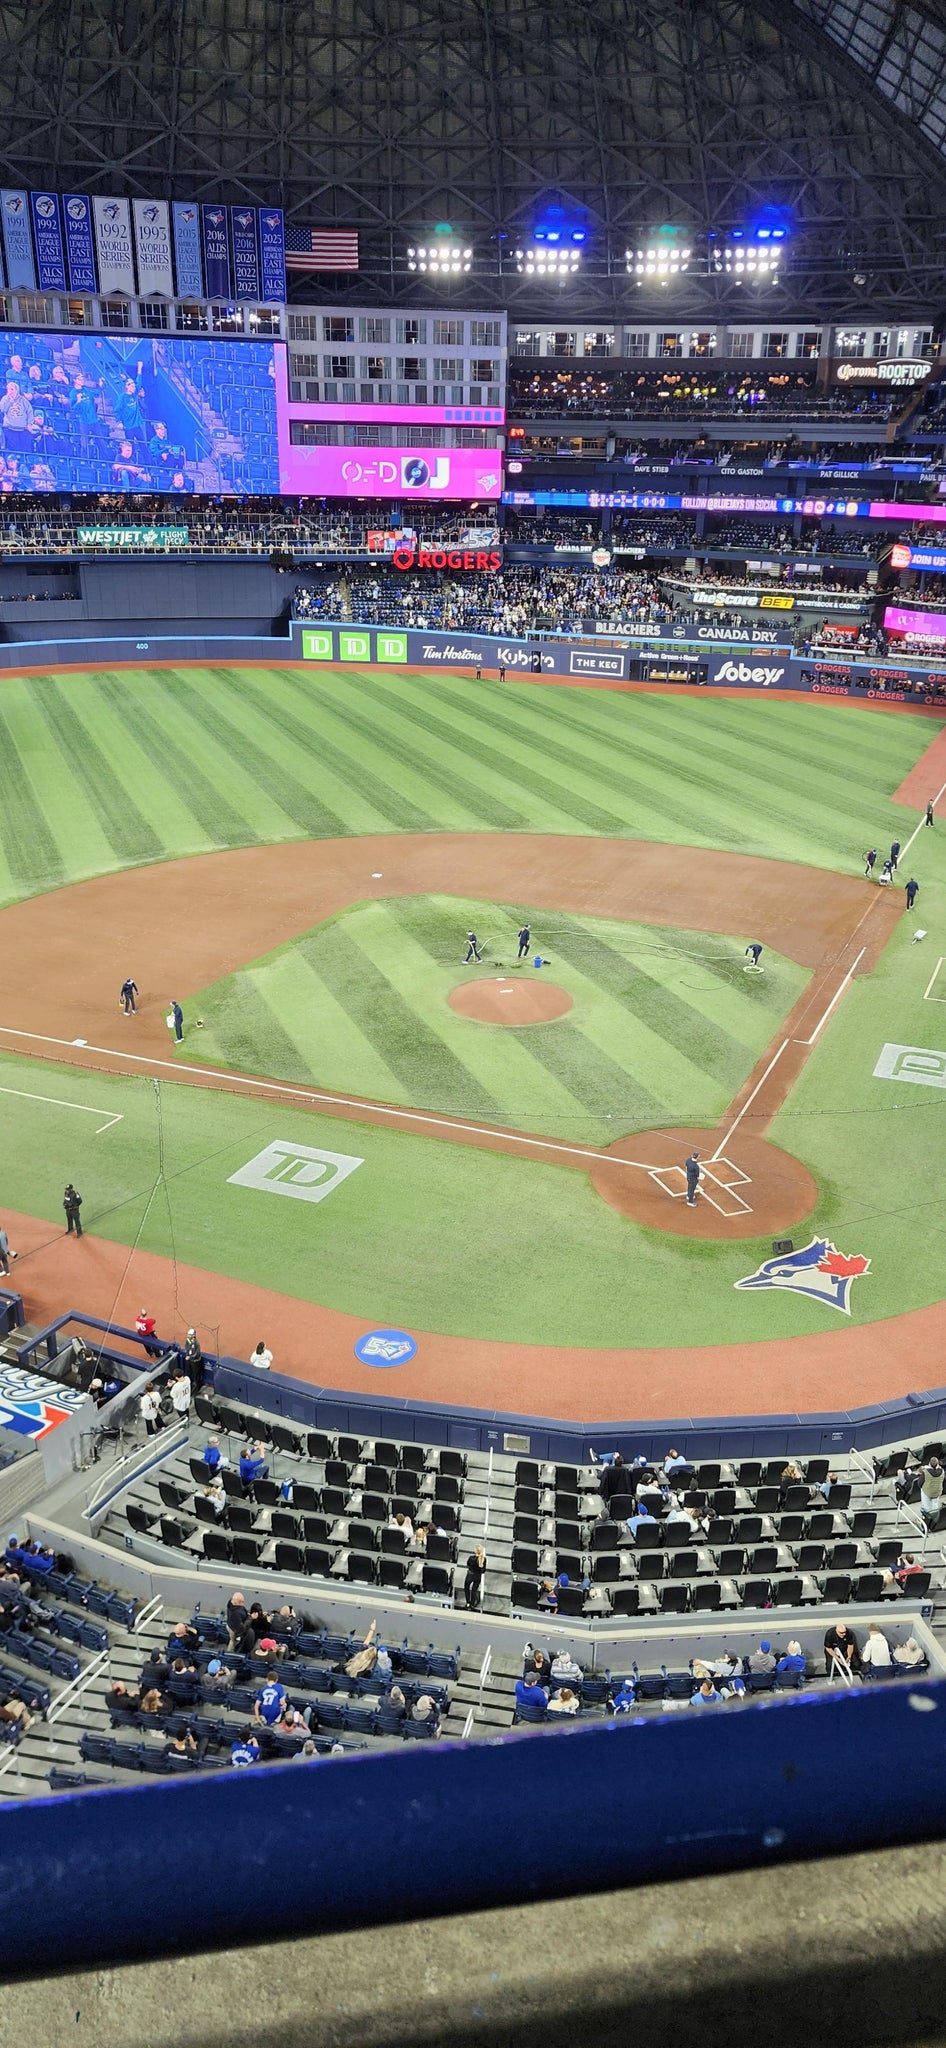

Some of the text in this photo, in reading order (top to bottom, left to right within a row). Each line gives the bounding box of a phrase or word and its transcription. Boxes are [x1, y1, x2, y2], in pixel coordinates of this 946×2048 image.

[37, 219, 57, 230] 1992
[69, 221, 88, 232] 1993
[99, 223, 128, 239] 1992
[140, 226, 166, 241] 1993
[178, 228, 196, 238] 2015
[207, 230, 225, 241] 2016
[38, 239, 59, 247] LEAGUE
[70, 240, 91, 248] LEAGUE
[236, 239, 254, 249] 2016
[263, 233, 282, 244] 2025
[40, 246, 60, 256] EAST
[100, 240, 129, 252] WORLD
[140, 243, 168, 254] WORLD
[207, 243, 226, 253] ALDS
[70, 248, 91, 257] EAST
[100, 251, 130, 262] SERIES
[236, 252, 255, 263] 2020
[264, 252, 282, 260] LEAGUE
[140, 253, 169, 264] SERIES
[179, 254, 198, 263] EAST
[264, 259, 282, 268] EAST
[100, 261, 130, 269] CHAMPIONS
[141, 263, 169, 271] CHAMPIONS
[41, 267, 62, 278] ALCS
[72, 269, 93, 280] ALCS
[237, 267, 256, 278] 2022
[237, 281, 257, 292] 2023
[265, 280, 284, 289] ALCS
[837, 363, 932, 381] Corona ROOFTOP
[891, 378, 915, 386] PATIO
[634, 465, 650, 473] DAVE
[737, 468, 763, 476] GASTON
[833, 471, 859, 479] GILLICK
[920, 474, 936, 482] PAUL
[681, 497, 778, 511] FOLLOW @BLUEJAYS ON SOCIAL
[80, 529, 142, 544] WESTJET
[165, 537, 184, 545] DECK
[418, 551, 501, 570] ROGERS
[912, 554, 932, 565] JOIN
[933, 556, 946, 567] US
[693, 591, 758, 606] theScore
[762, 597, 793, 607] BET
[796, 599, 833, 608] SPORTSBOOK
[839, 602, 861, 610] CASINO
[595, 622, 661, 636] BLEACHERS
[698, 627, 750, 642] CANADA
[914, 633, 946, 643] ROGERS
[305, 636, 330, 654] TD
[342, 637, 367, 656] TD
[380, 639, 404, 657] TD
[422, 645, 483, 661] Tim Hortons
[576, 658, 618, 669] THE KEG
[822, 664, 851, 674] ROGERS
[714, 660, 785, 686] Sobeys
[878, 670, 908, 679] ROGERS
[820, 686, 849, 695] ROGERS
[875, 691, 905, 701] ROGERS
[264, 1150, 339, 1187] TD
